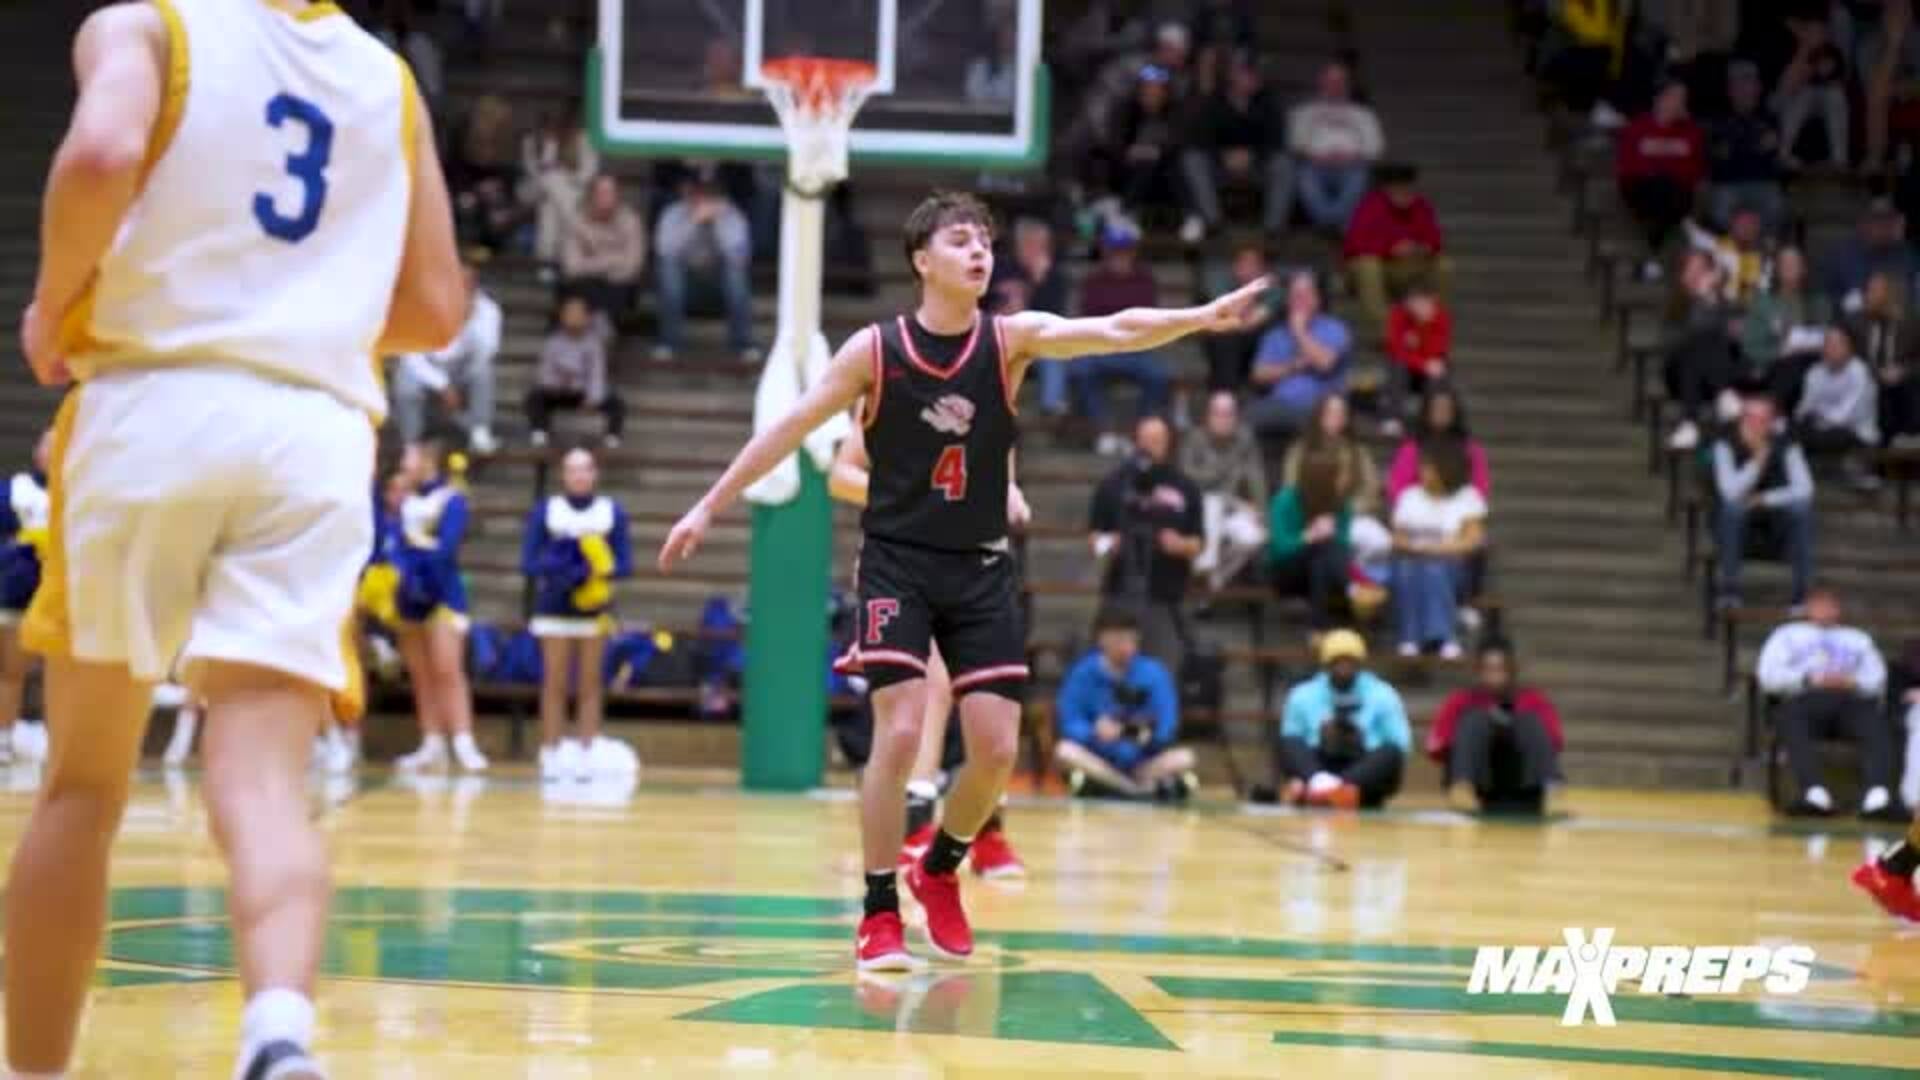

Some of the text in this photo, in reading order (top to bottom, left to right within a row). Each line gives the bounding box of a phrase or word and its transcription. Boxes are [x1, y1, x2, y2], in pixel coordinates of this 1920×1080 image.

[253, 92, 334, 243] 3
[931, 445, 967, 501] 4
[866, 597, 900, 644] F
